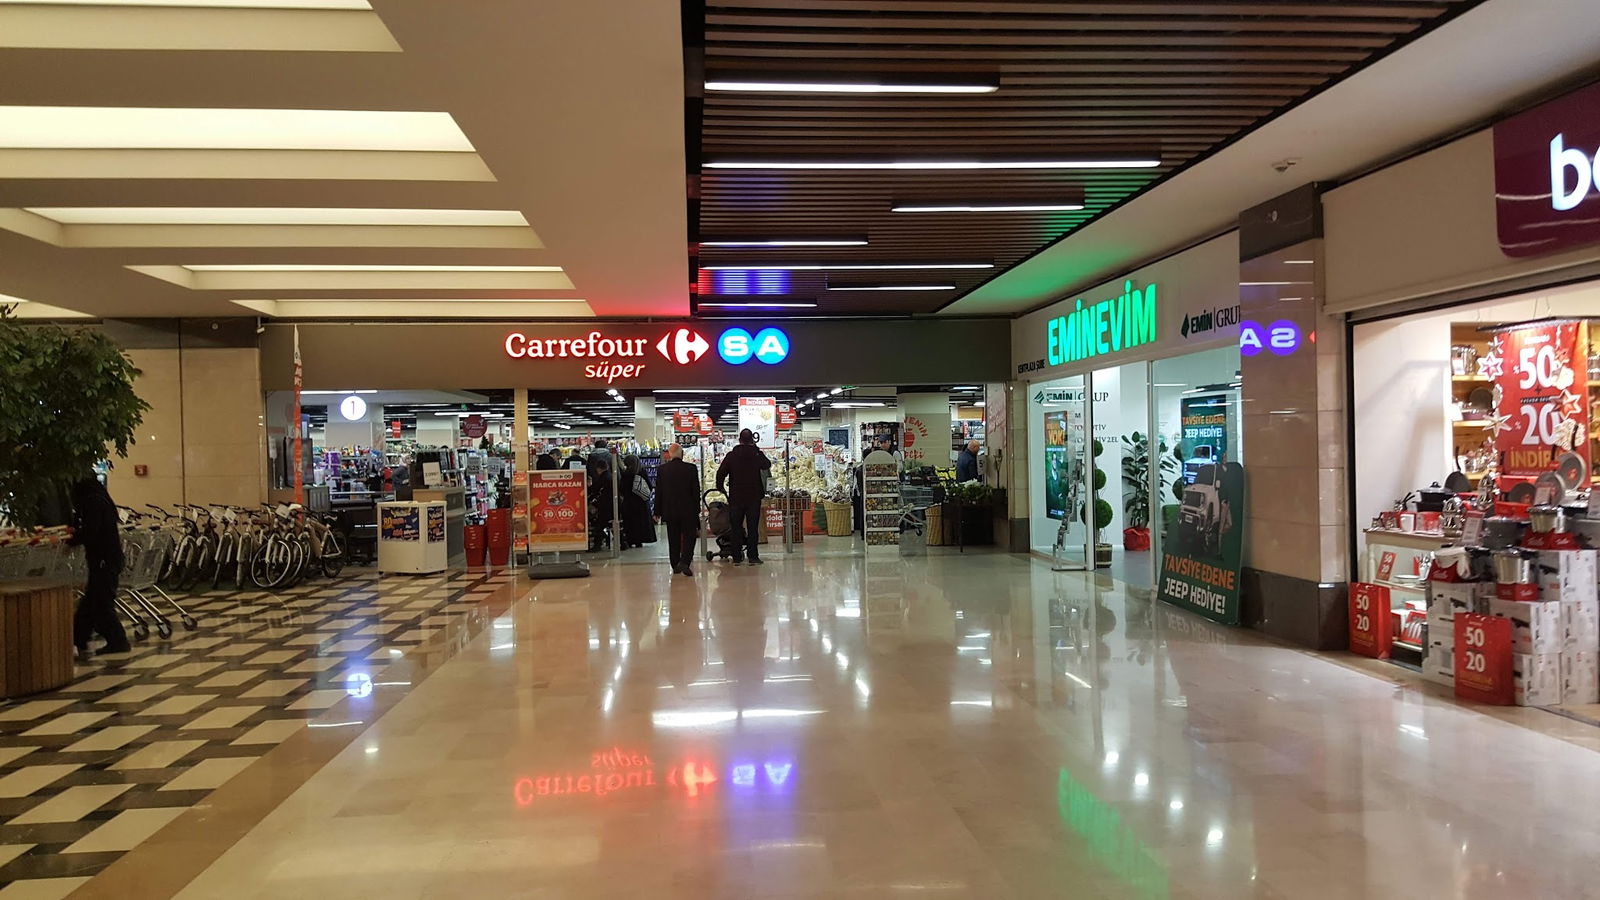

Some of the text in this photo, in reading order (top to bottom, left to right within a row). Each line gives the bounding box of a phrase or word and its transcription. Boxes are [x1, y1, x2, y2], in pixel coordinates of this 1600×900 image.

[1550, 132, 1600, 211] b
[1048, 280, 1157, 366] EMİNEVİM
[1190, 310, 1213, 334] EMİN
[504, 331, 787, 358] Carrefour SA
[584, 361, 646, 384] süper
[1184, 428, 1199, 438] JEEP
[1164, 554, 1235, 590] TAVSİYE EDENE
[1164, 578, 1226, 615] JEEP HEDİYE!
[1356, 594, 1370, 611] 50
[1356, 614, 1370, 632] 20
[1465, 627, 1485, 647] 50
[1465, 651, 1486, 673] 20
